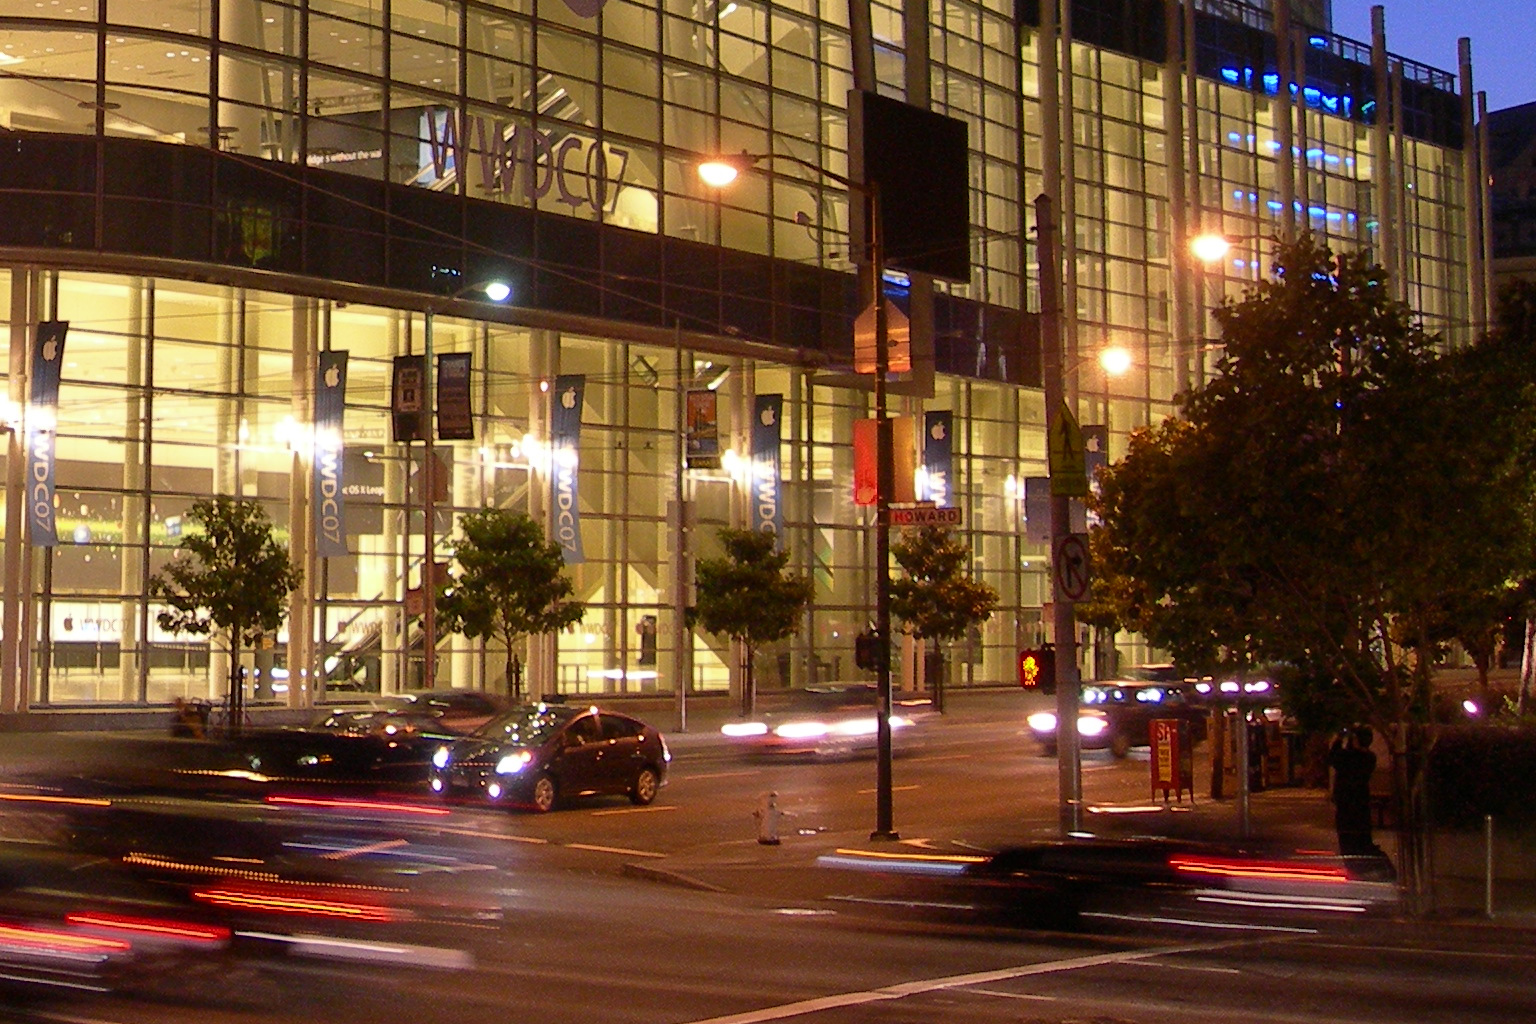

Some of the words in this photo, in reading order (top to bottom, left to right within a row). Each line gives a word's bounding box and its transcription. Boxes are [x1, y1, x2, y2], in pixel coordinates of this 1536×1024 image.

[425, 105, 630, 213] WWDC07
[33, 430, 52, 534] WDC07
[320, 446, 341, 545] WDC07
[557, 466, 577, 553] WDC07
[894, 510, 958, 524] HOWARD
